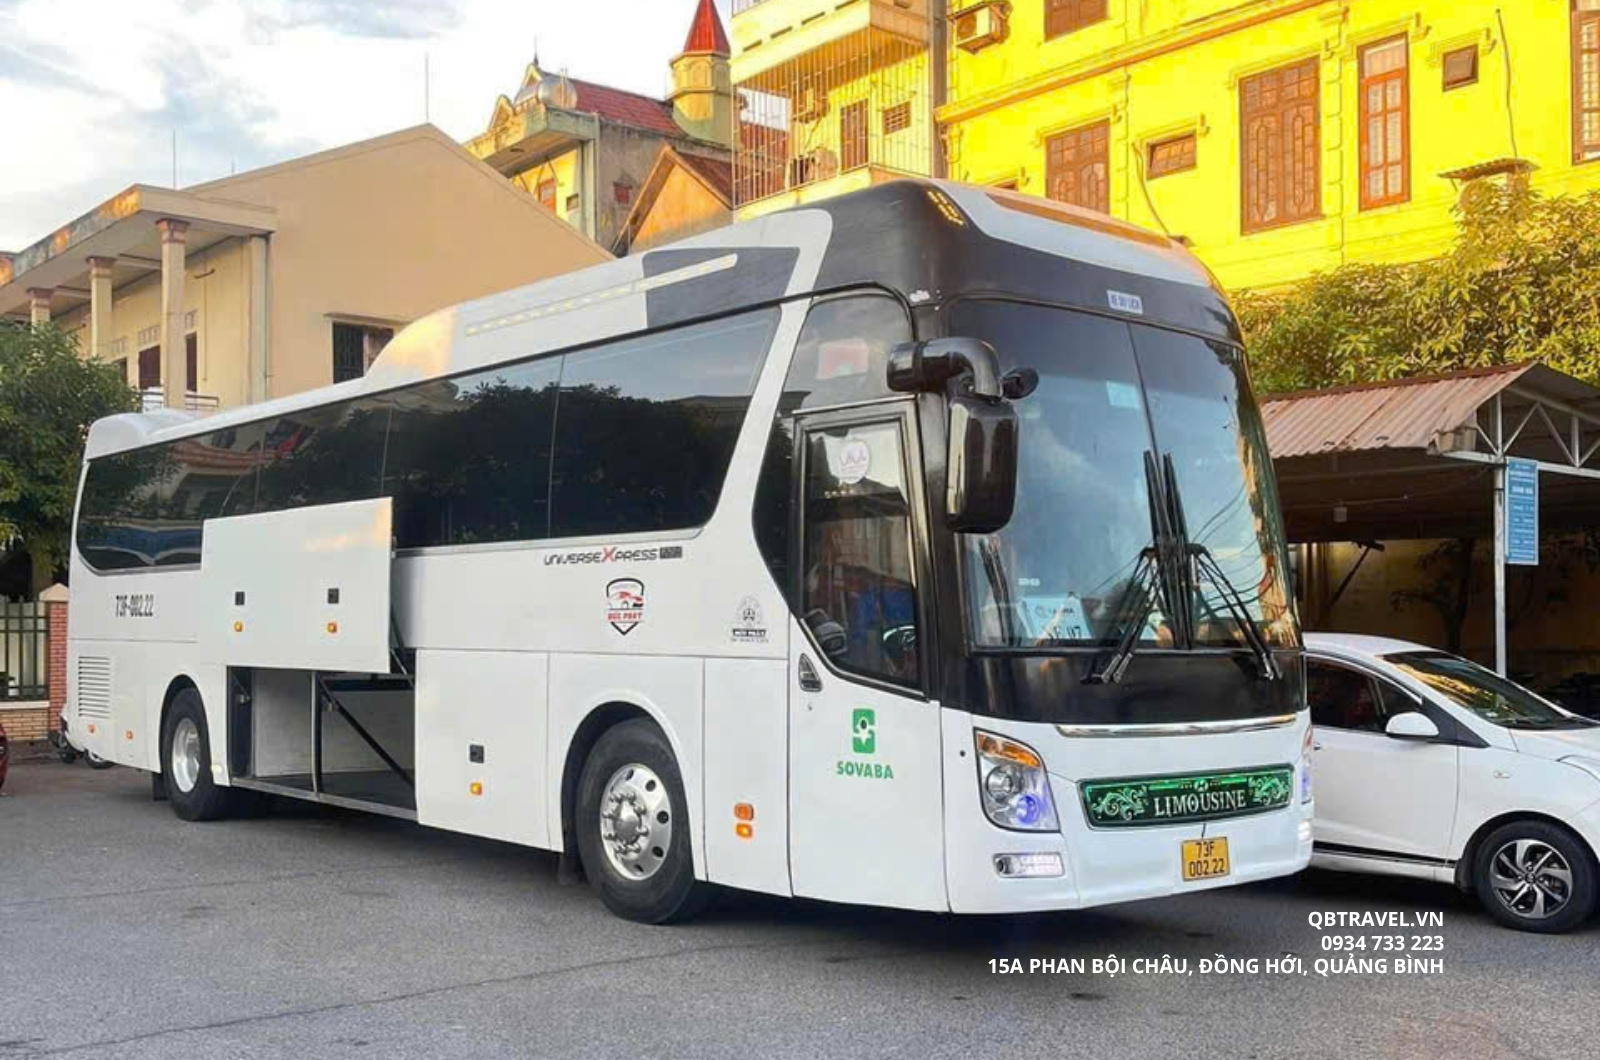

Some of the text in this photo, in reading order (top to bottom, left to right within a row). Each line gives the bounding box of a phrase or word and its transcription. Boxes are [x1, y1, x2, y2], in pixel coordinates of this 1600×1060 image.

[836, 760, 894, 779] SOVABA
[1154, 789, 1247, 818] LIMOUSINE
[1196, 841, 1216, 858] 73F
[1189, 858, 1226, 877] 002.22
